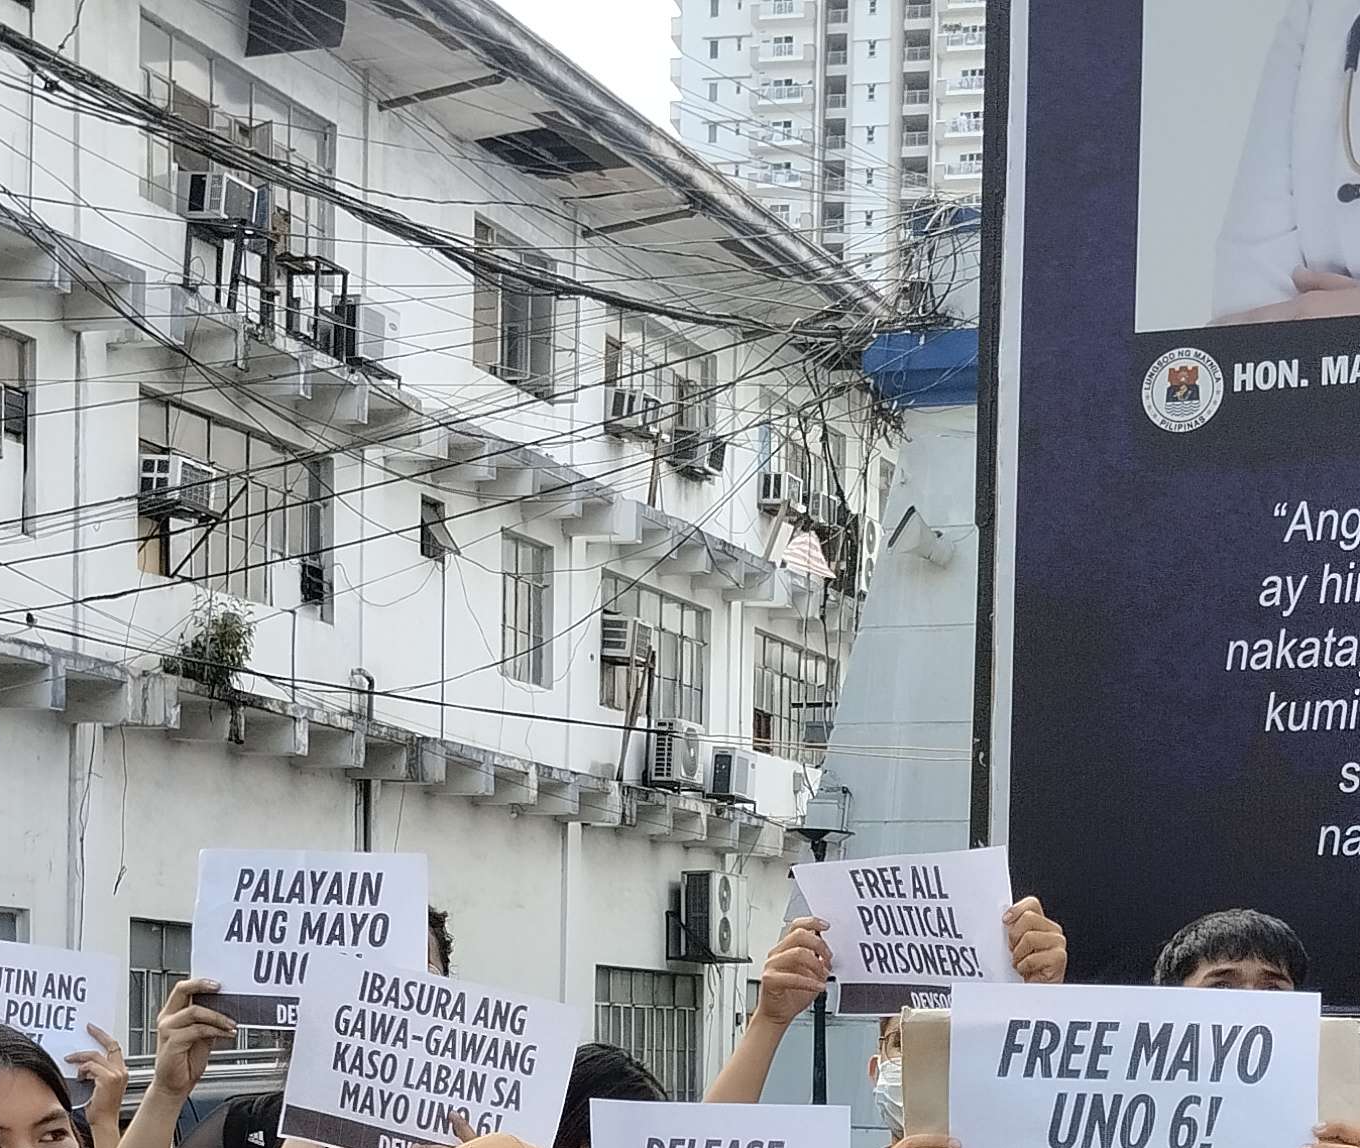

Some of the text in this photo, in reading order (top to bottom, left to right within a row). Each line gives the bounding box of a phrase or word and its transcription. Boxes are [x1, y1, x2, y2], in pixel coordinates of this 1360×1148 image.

[1233, 358, 1309, 392] HON.
[1259, 576, 1308, 617] ay
[234, 869, 383, 907] PALAYAIN
[849, 865, 949, 899] FREE ALL
[225, 909, 390, 948] ANG MAYO
[856, 904, 963, 939] POLITICAL
[859, 942, 983, 978] PRISONERS!
[42, 973, 87, 1002] ANG
[359, 971, 528, 1035] IBASURA ANG
[5, 999, 77, 1031] POLICE
[334, 1005, 537, 1076] GAWA-GAWANG
[997, 1019, 1273, 1084] FREE MAYO
[333, 1042, 521, 1112] KASO LABAN SA
[339, 1080, 409, 1124] MAYO
[477, 1111, 503, 1136] 6!
